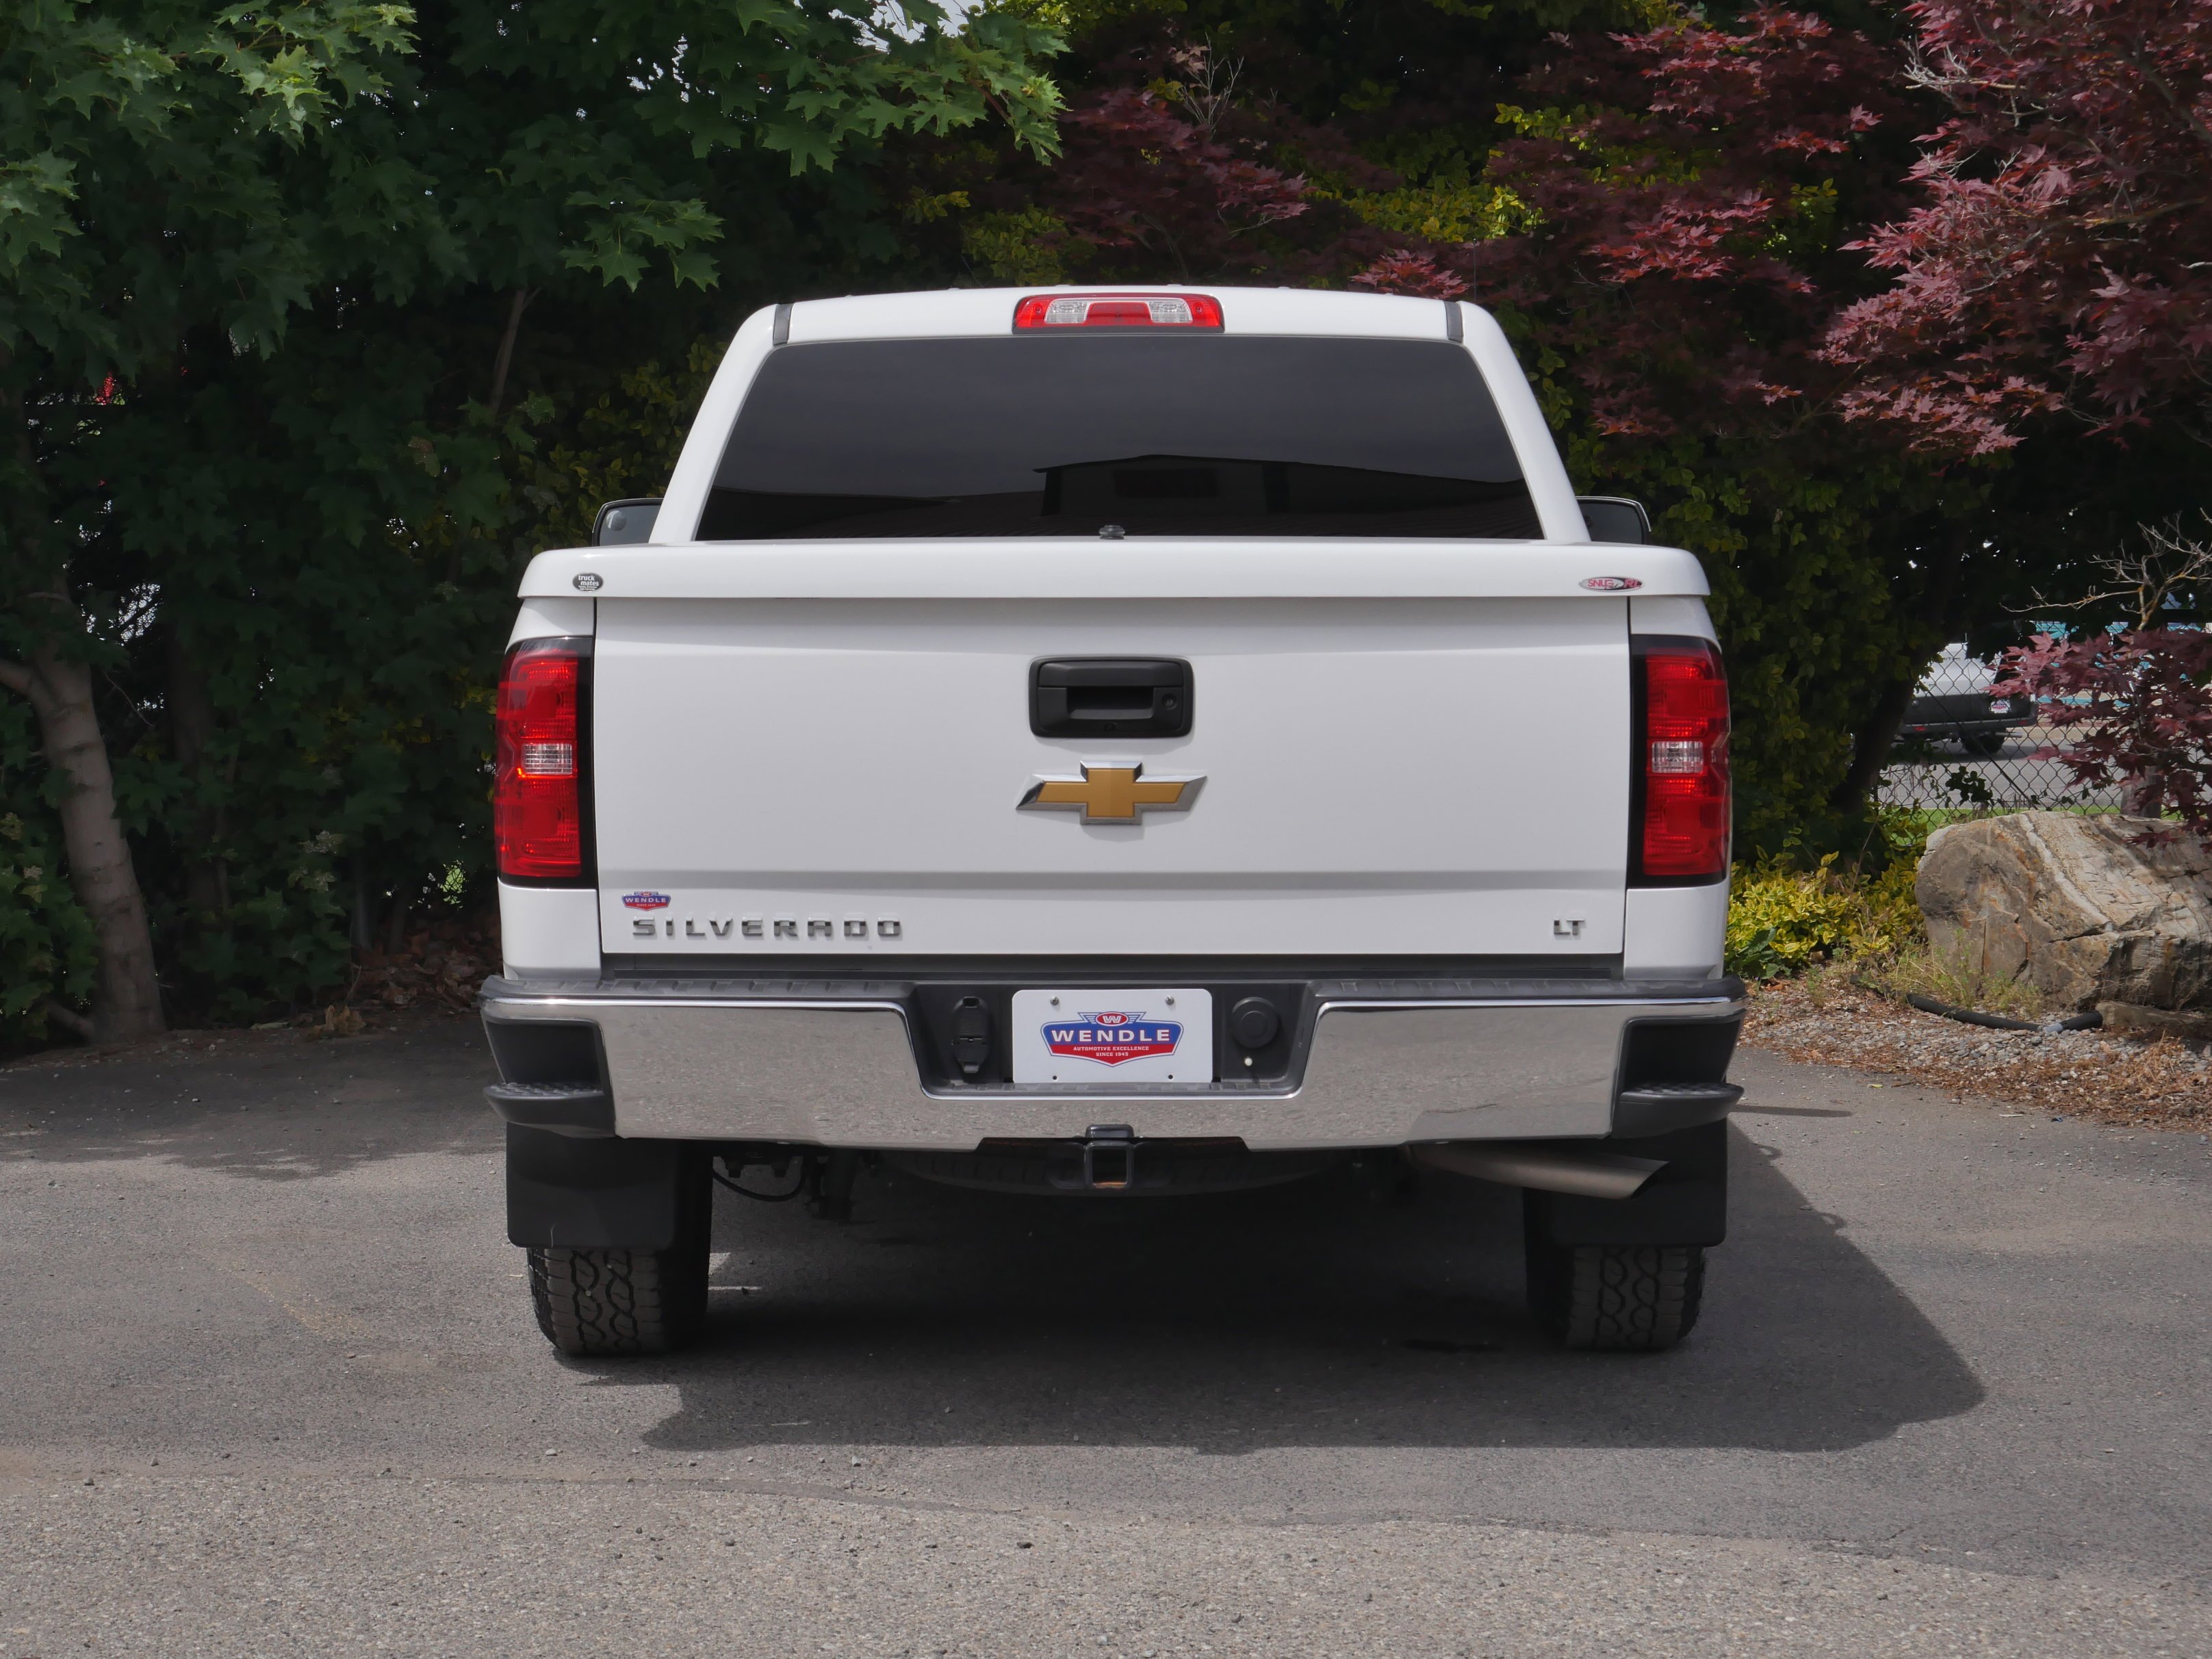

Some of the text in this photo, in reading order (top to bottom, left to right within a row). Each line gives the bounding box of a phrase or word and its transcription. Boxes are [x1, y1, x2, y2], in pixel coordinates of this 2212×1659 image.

[1587, 579, 1615, 587] SNUG
[632, 916, 901, 936] SILVERADO
[1554, 918, 1585, 936] LT
[1051, 1029, 1170, 1042] WENDLE
